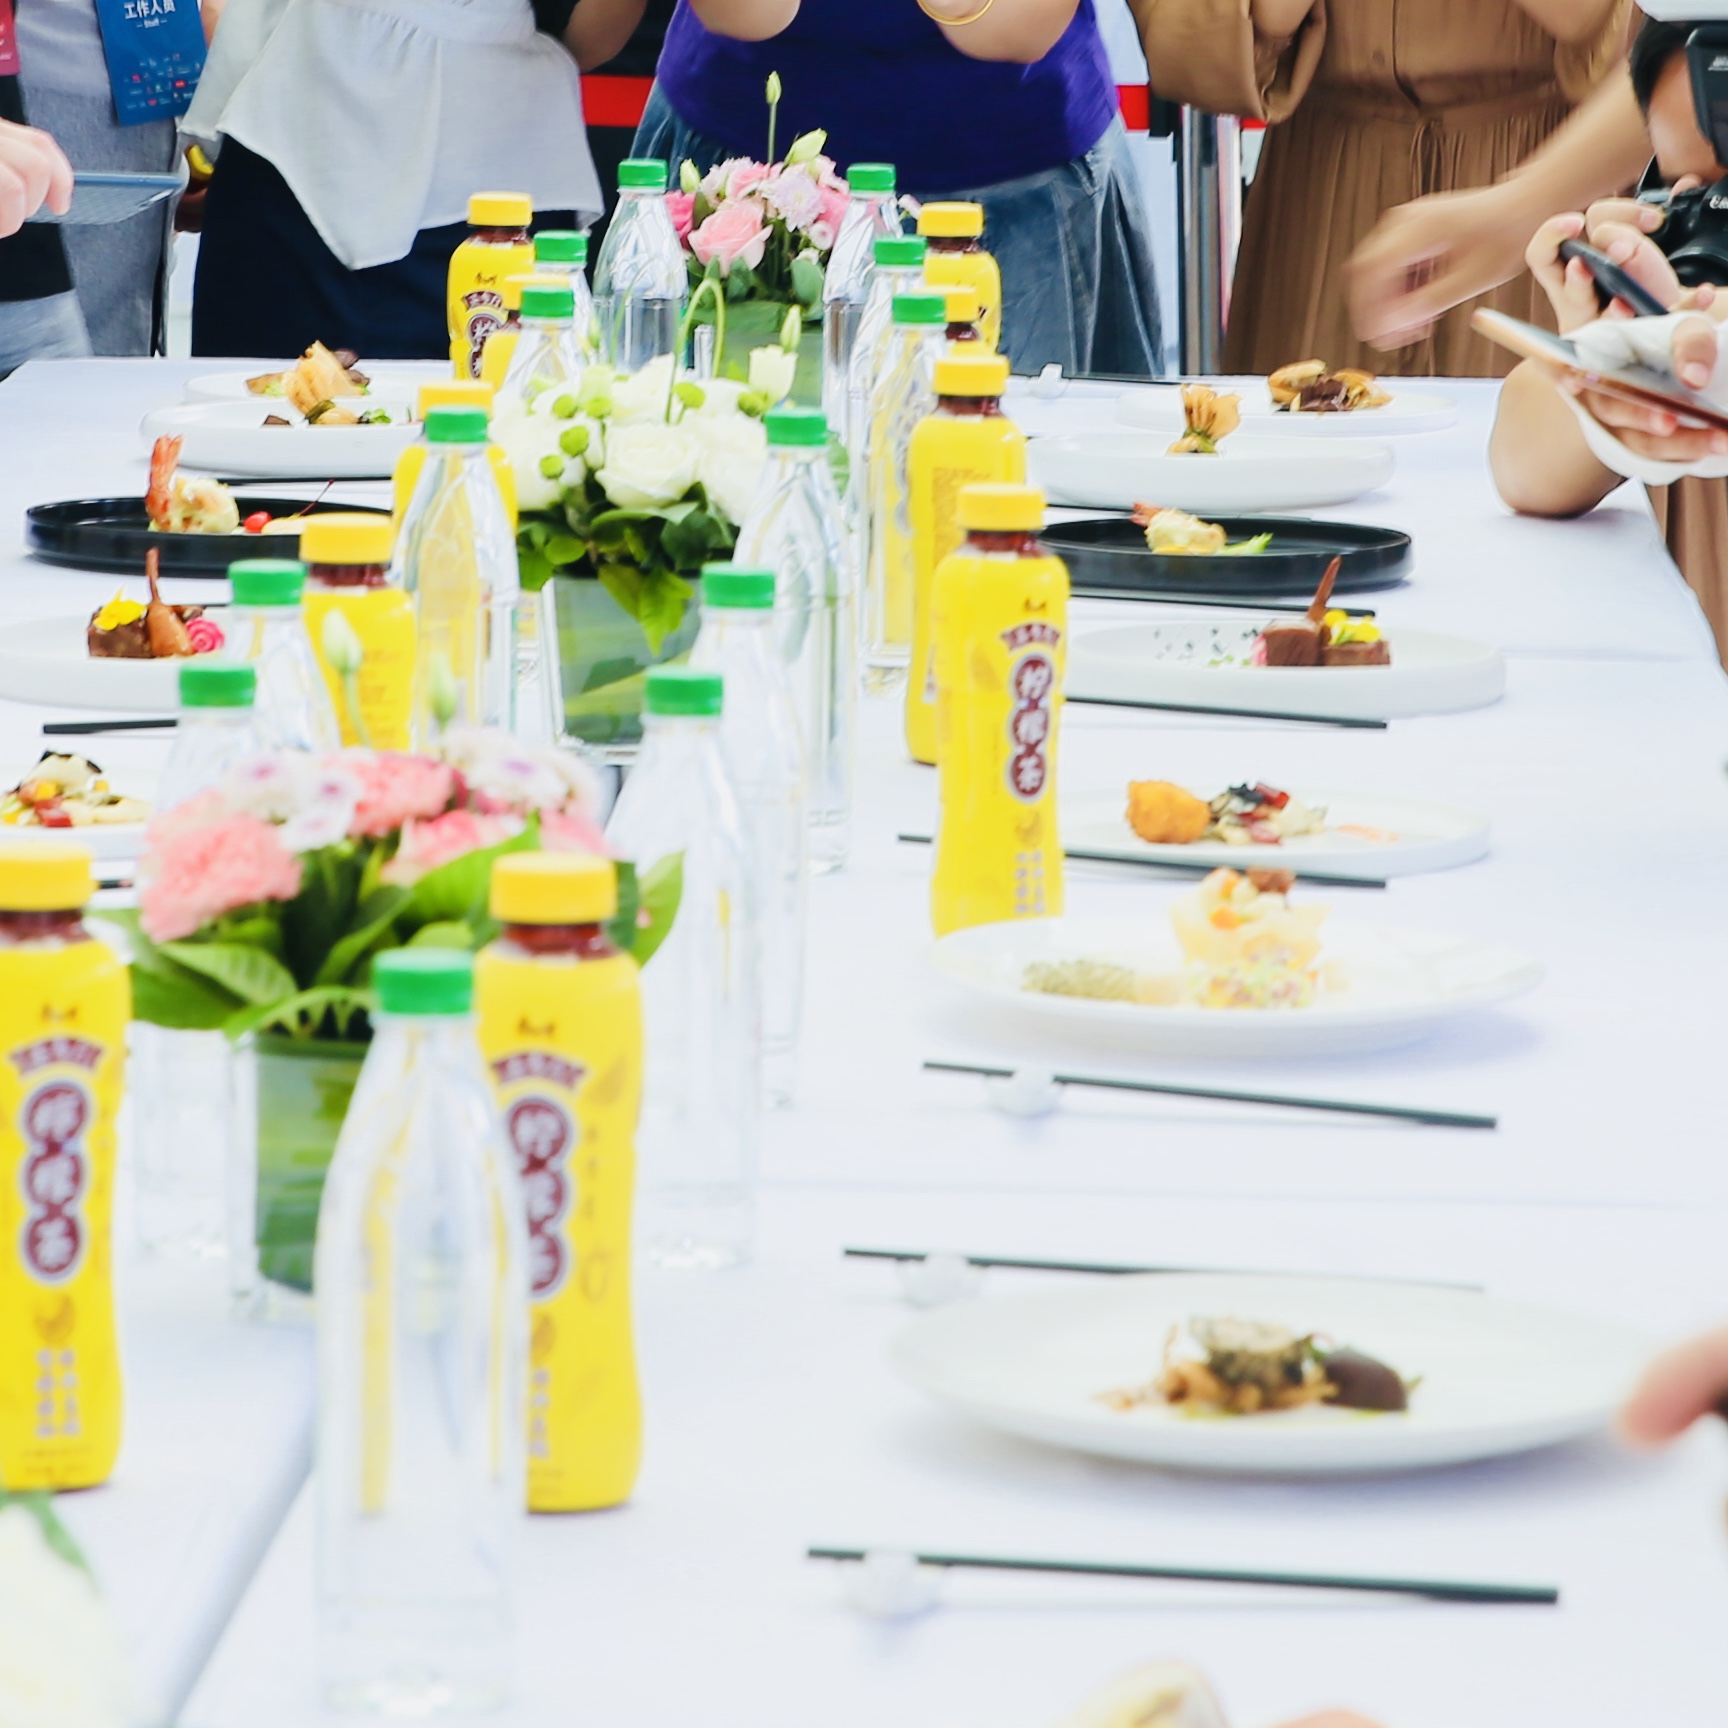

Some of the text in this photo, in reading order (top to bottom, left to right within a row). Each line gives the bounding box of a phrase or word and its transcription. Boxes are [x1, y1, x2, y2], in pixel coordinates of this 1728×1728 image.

[1016, 663, 1050, 791] 柠檬茶
[32, 1093, 78, 1268] 柠檬茶
